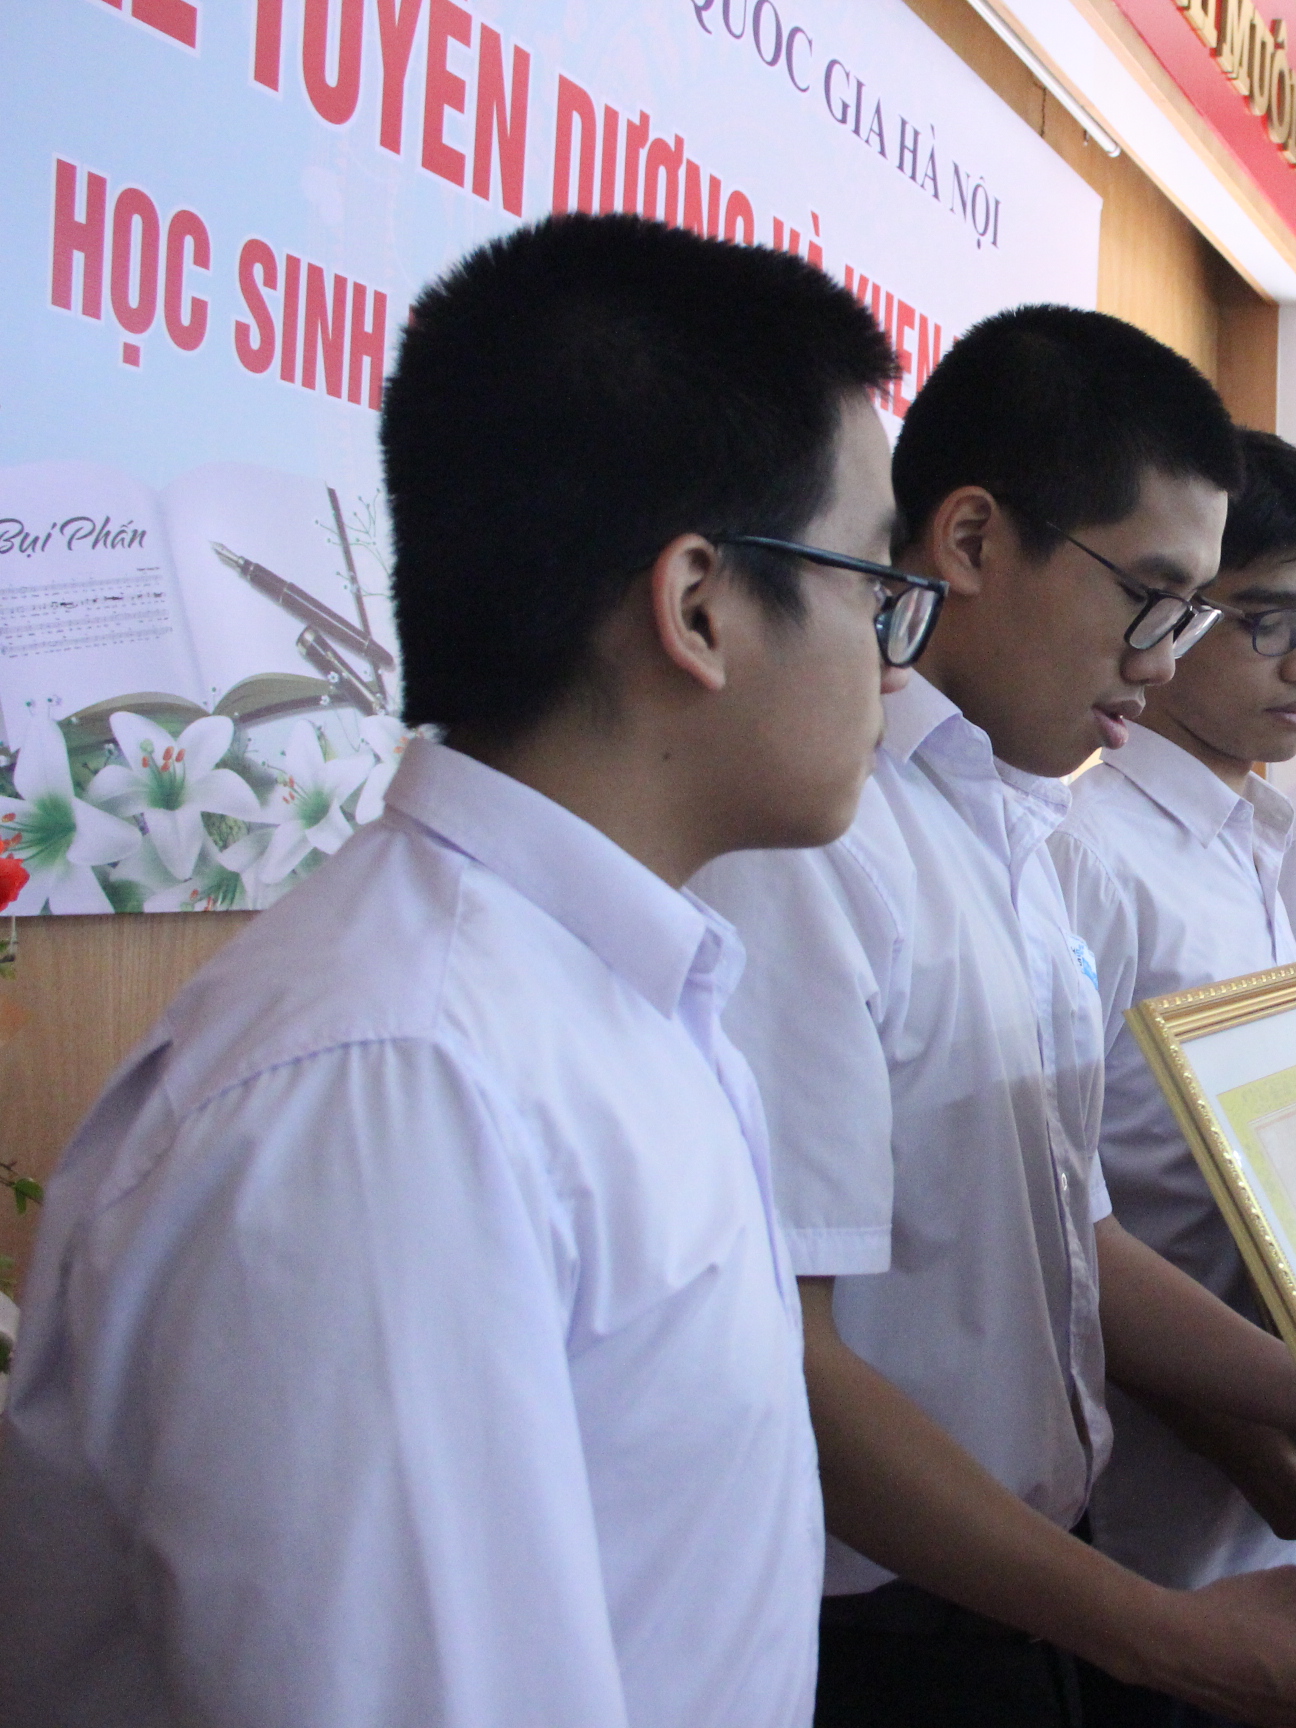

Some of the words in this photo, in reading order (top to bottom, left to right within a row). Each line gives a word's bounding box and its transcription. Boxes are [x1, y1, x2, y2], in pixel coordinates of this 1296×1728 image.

[824, 59, 888, 160] GIA
[896, 114, 940, 202] HÀ
[950, 160, 1001, 250] NỘI
[51, 158, 211, 367] HỌC
[234, 238, 387, 411] SINH
[0, 518, 57, 558] Bụi
[59, 515, 147, 551] Phấn
